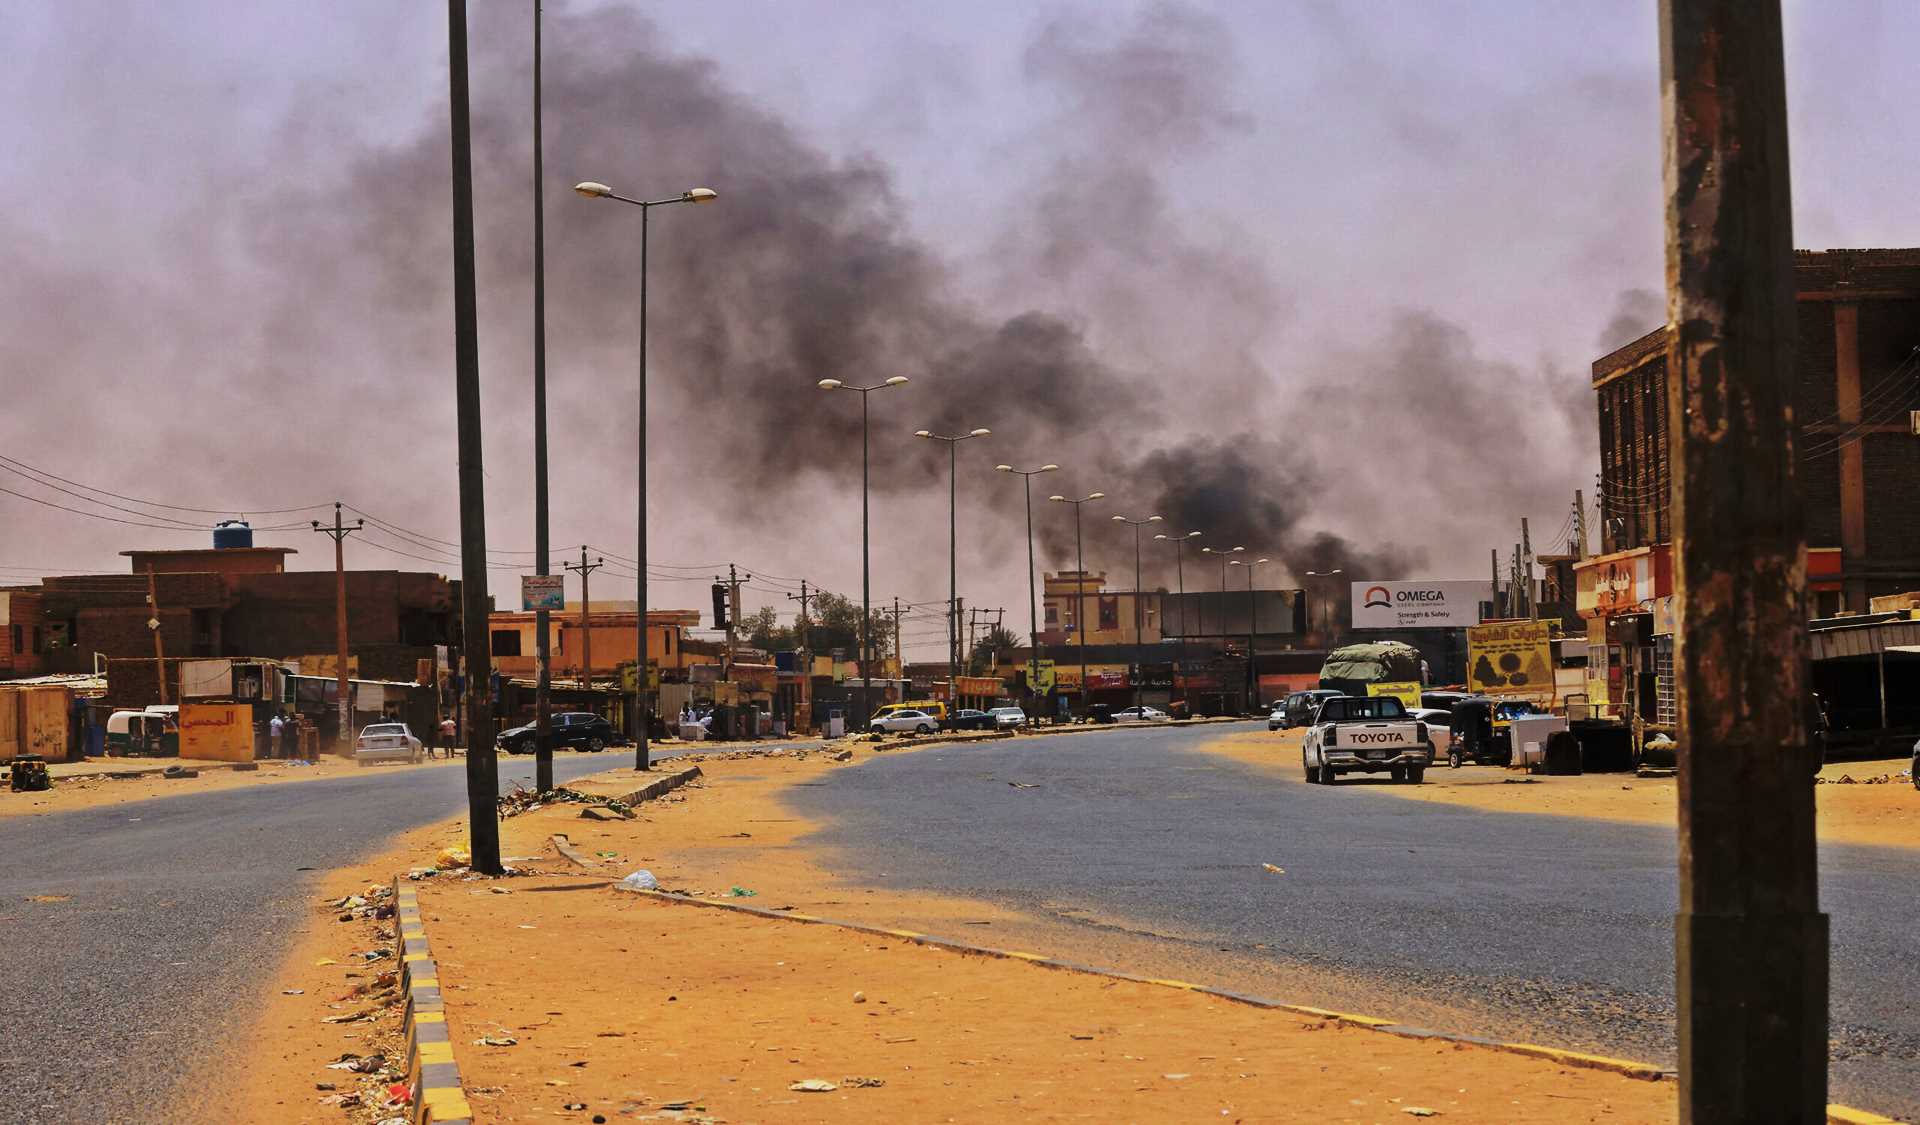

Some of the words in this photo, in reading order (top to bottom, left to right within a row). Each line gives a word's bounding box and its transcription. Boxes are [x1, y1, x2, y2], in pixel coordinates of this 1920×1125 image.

[1397, 591, 1445, 602] OMEGA
[1398, 611, 1423, 619] Strength
[1350, 733, 1404, 744] TOYOTA
